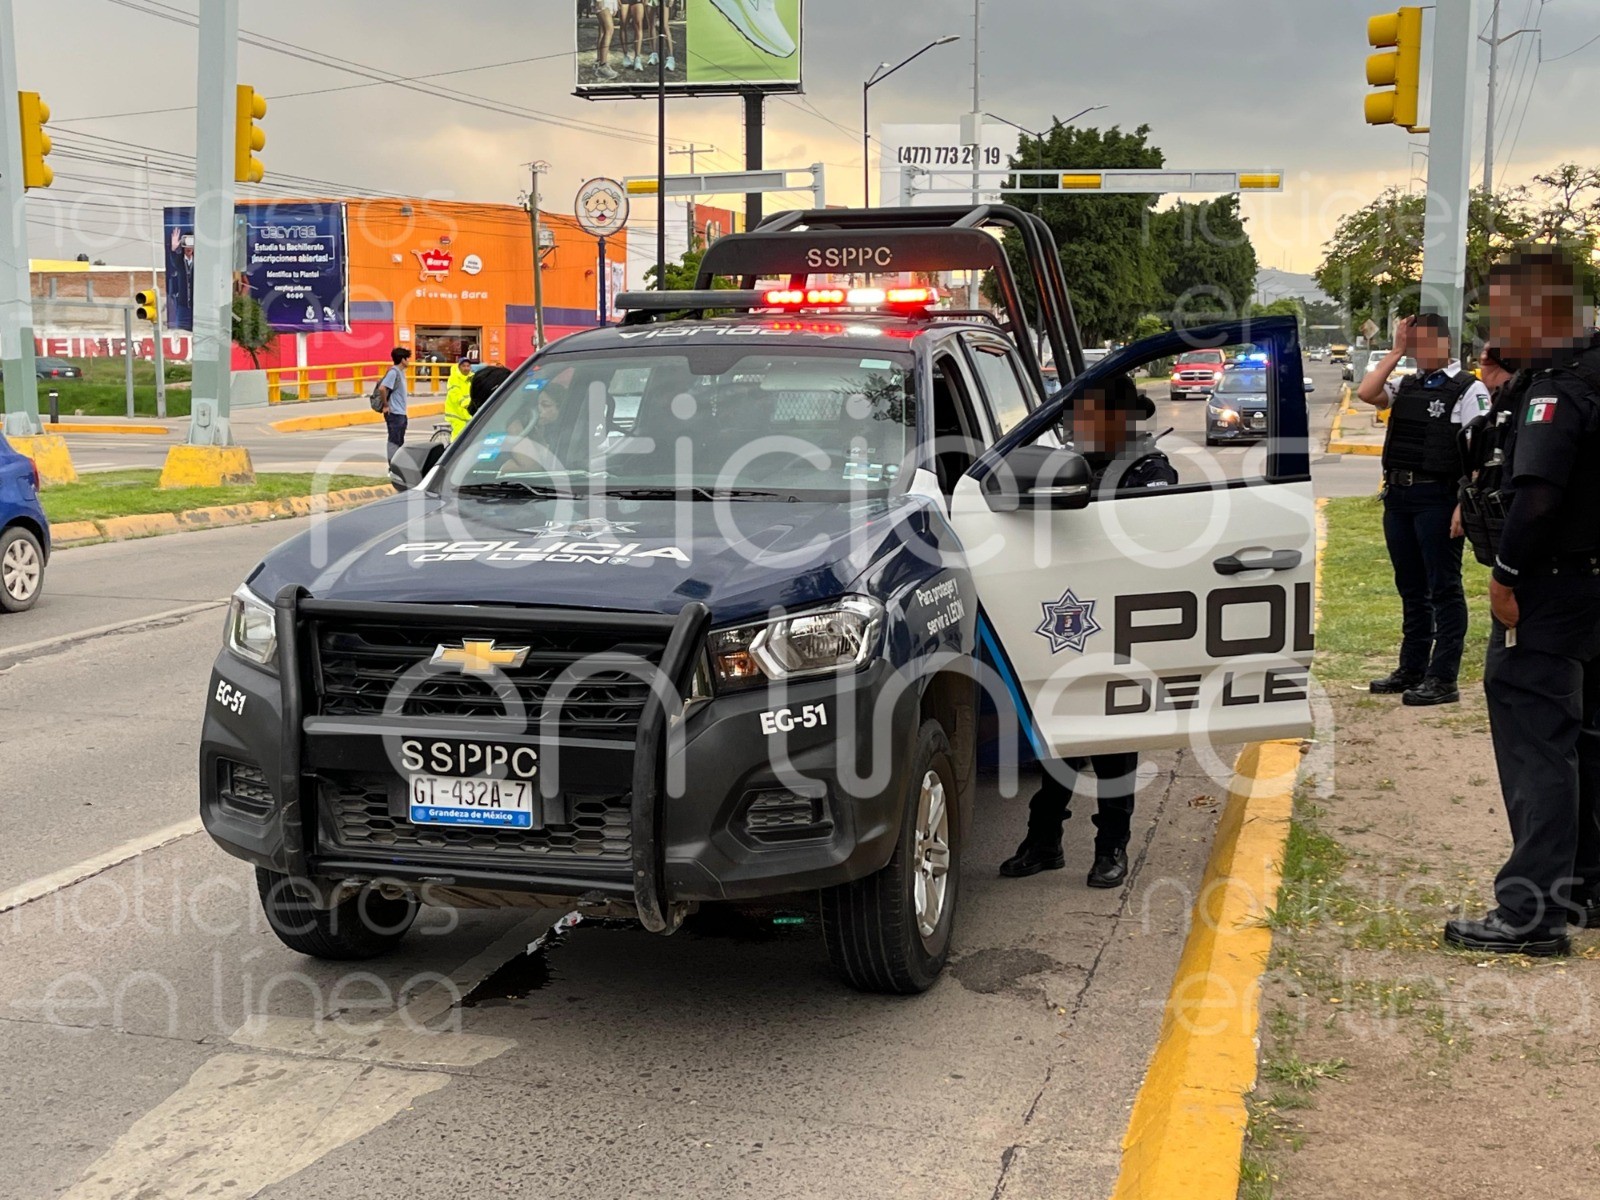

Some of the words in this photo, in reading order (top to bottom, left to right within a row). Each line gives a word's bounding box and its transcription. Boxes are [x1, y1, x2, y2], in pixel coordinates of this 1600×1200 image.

[898, 147, 931, 164] (477)
[935, 147, 958, 164] 773
[984, 147, 1000, 164] 19
[255, 243, 278, 251] Estudia
[286, 243, 324, 252] Bachillerato
[807, 246, 891, 268] SSPPC
[298, 254, 328, 262] abiertas!
[426, 258, 450, 267] Bara
[461, 290, 488, 300] Bara
[385, 541, 691, 562] POLICIA
[414, 553, 480, 562] DE
[916, 589, 934, 607] Para
[926, 610, 946, 636] servir
[216, 680, 246, 716] EG-51
[1105, 674, 1202, 716] DE
[760, 703, 828, 735] EG-51
[402, 740, 538, 778] SSPPC
[414, 778, 526, 808] GT-432A-7
[428, 808, 469, 818] Grandeza
[471, 810, 482, 818] de
[483, 810, 513, 820] México
